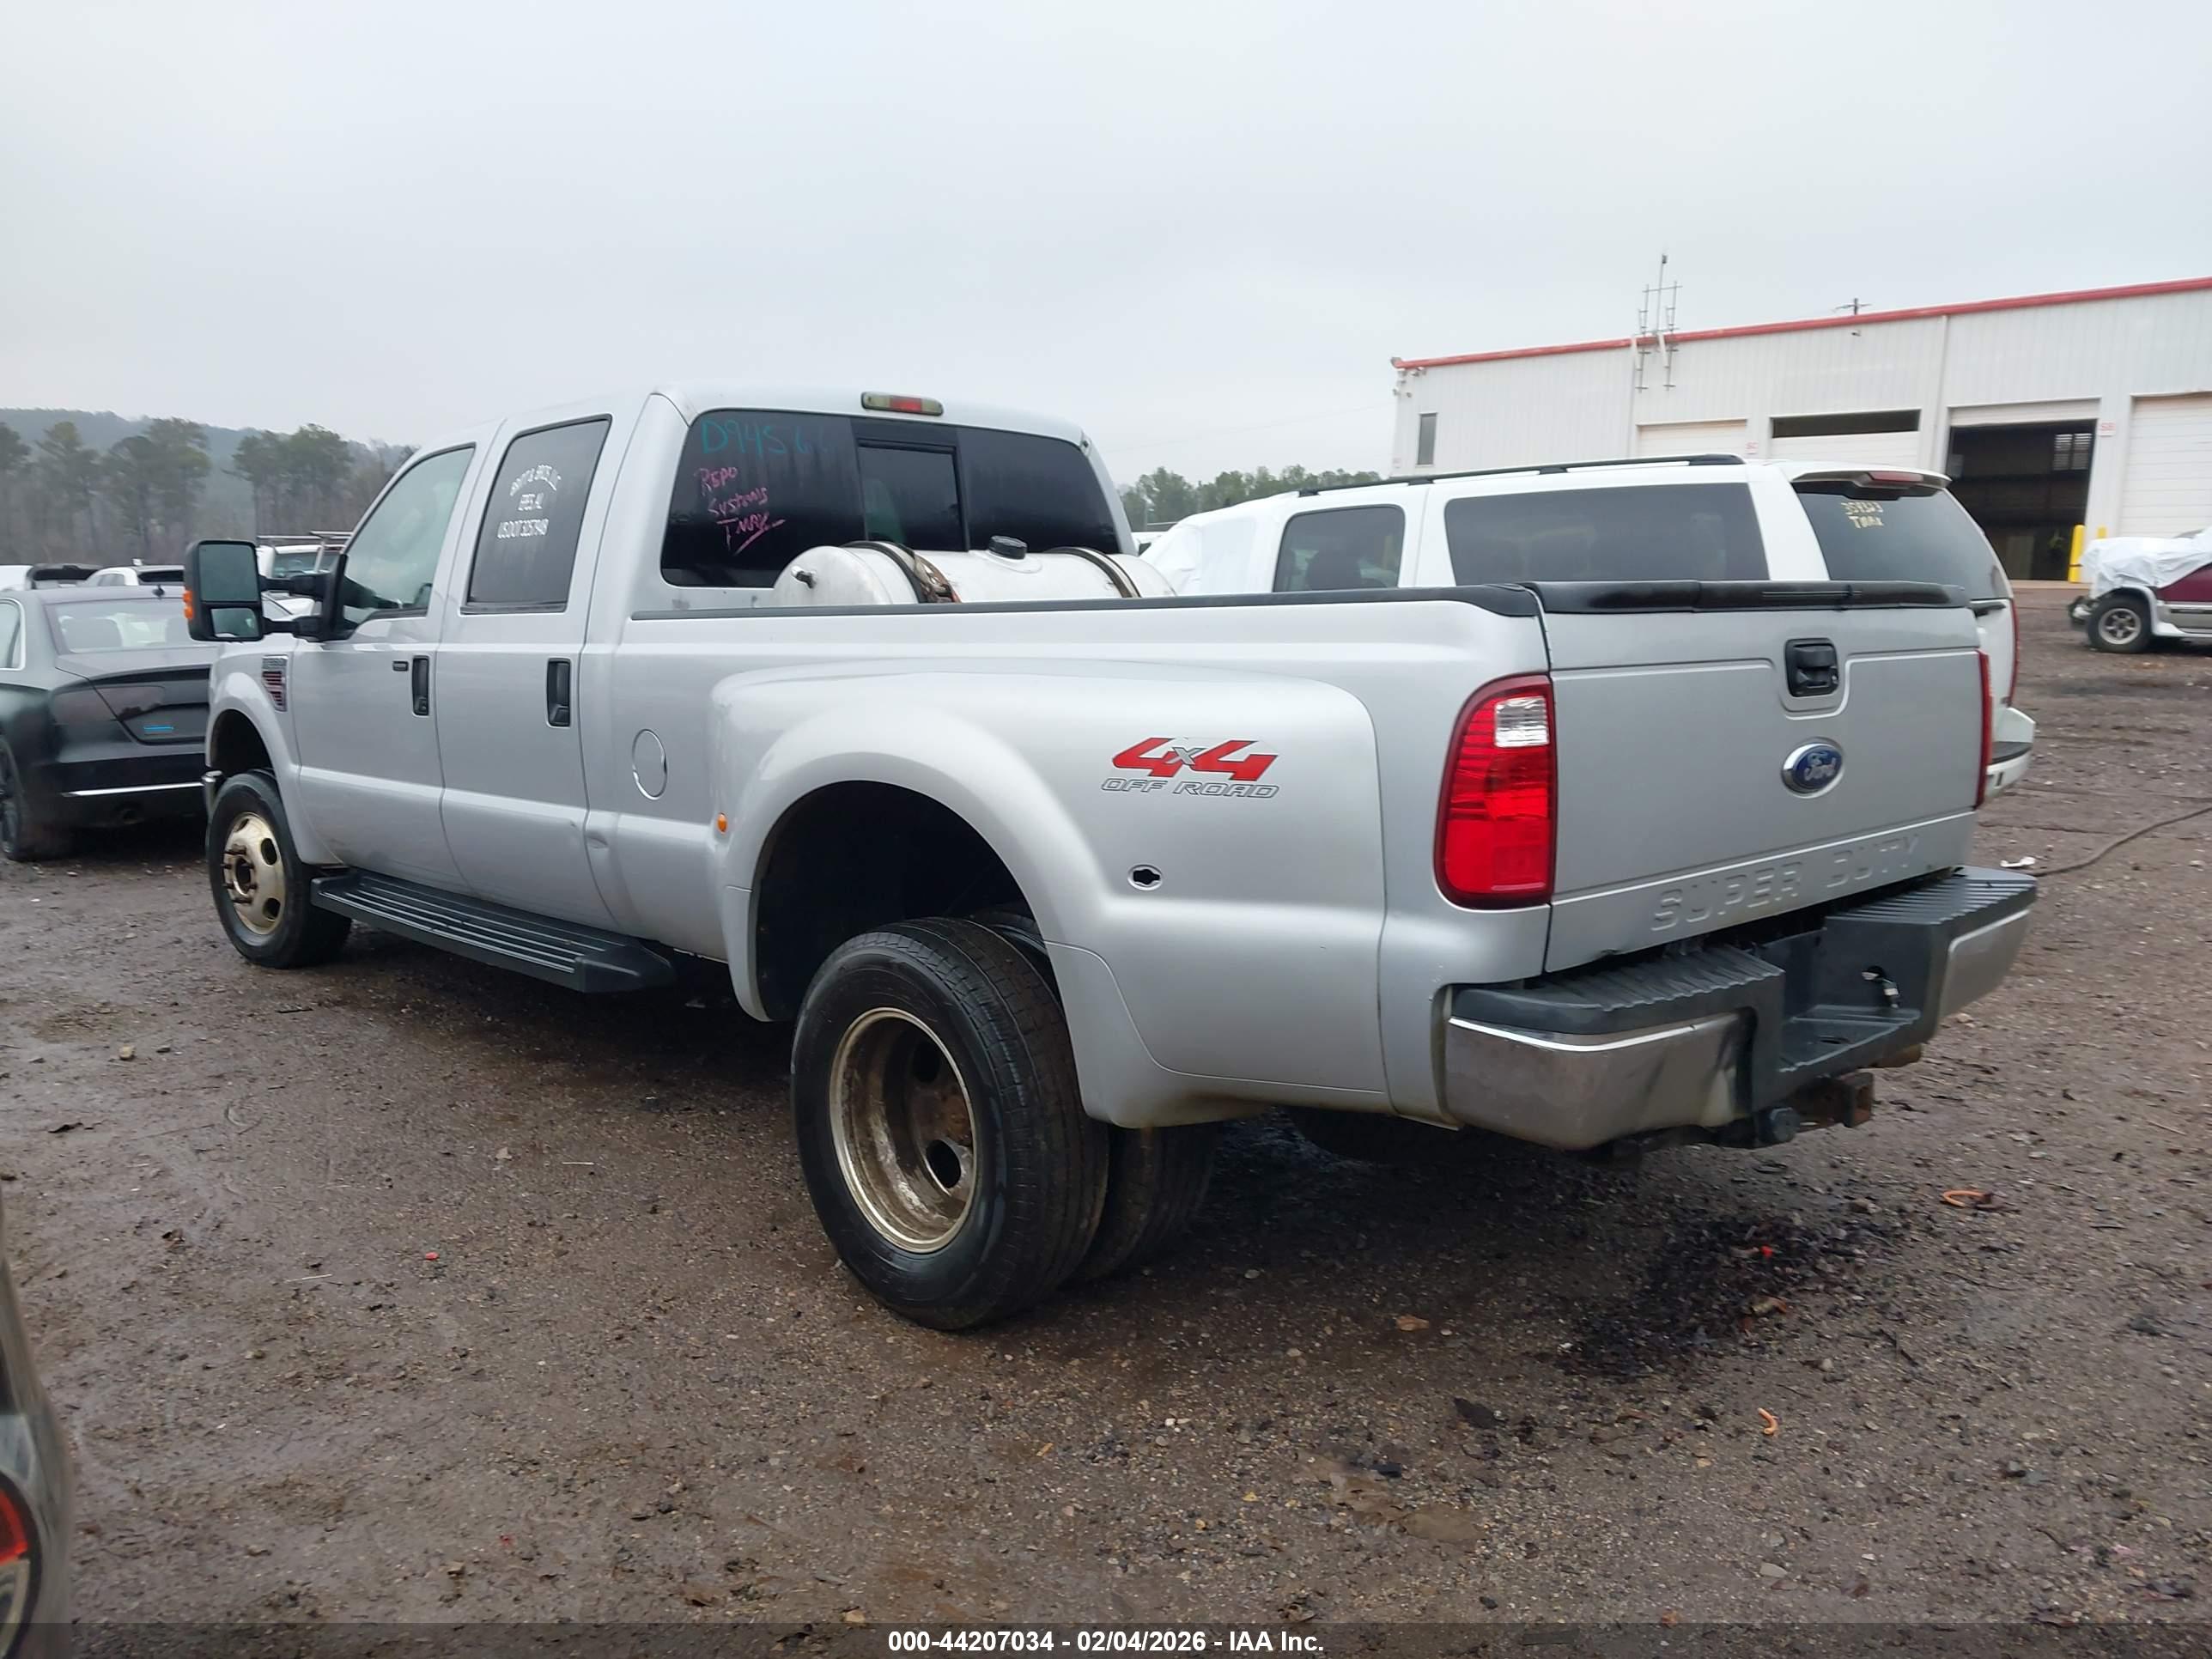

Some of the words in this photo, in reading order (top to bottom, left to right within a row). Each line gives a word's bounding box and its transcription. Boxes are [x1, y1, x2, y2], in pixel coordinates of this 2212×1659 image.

[1101, 777, 1169, 793] OFF
[1172, 781, 1280, 799] ROAD
[1650, 860, 1803, 932] SUPER
